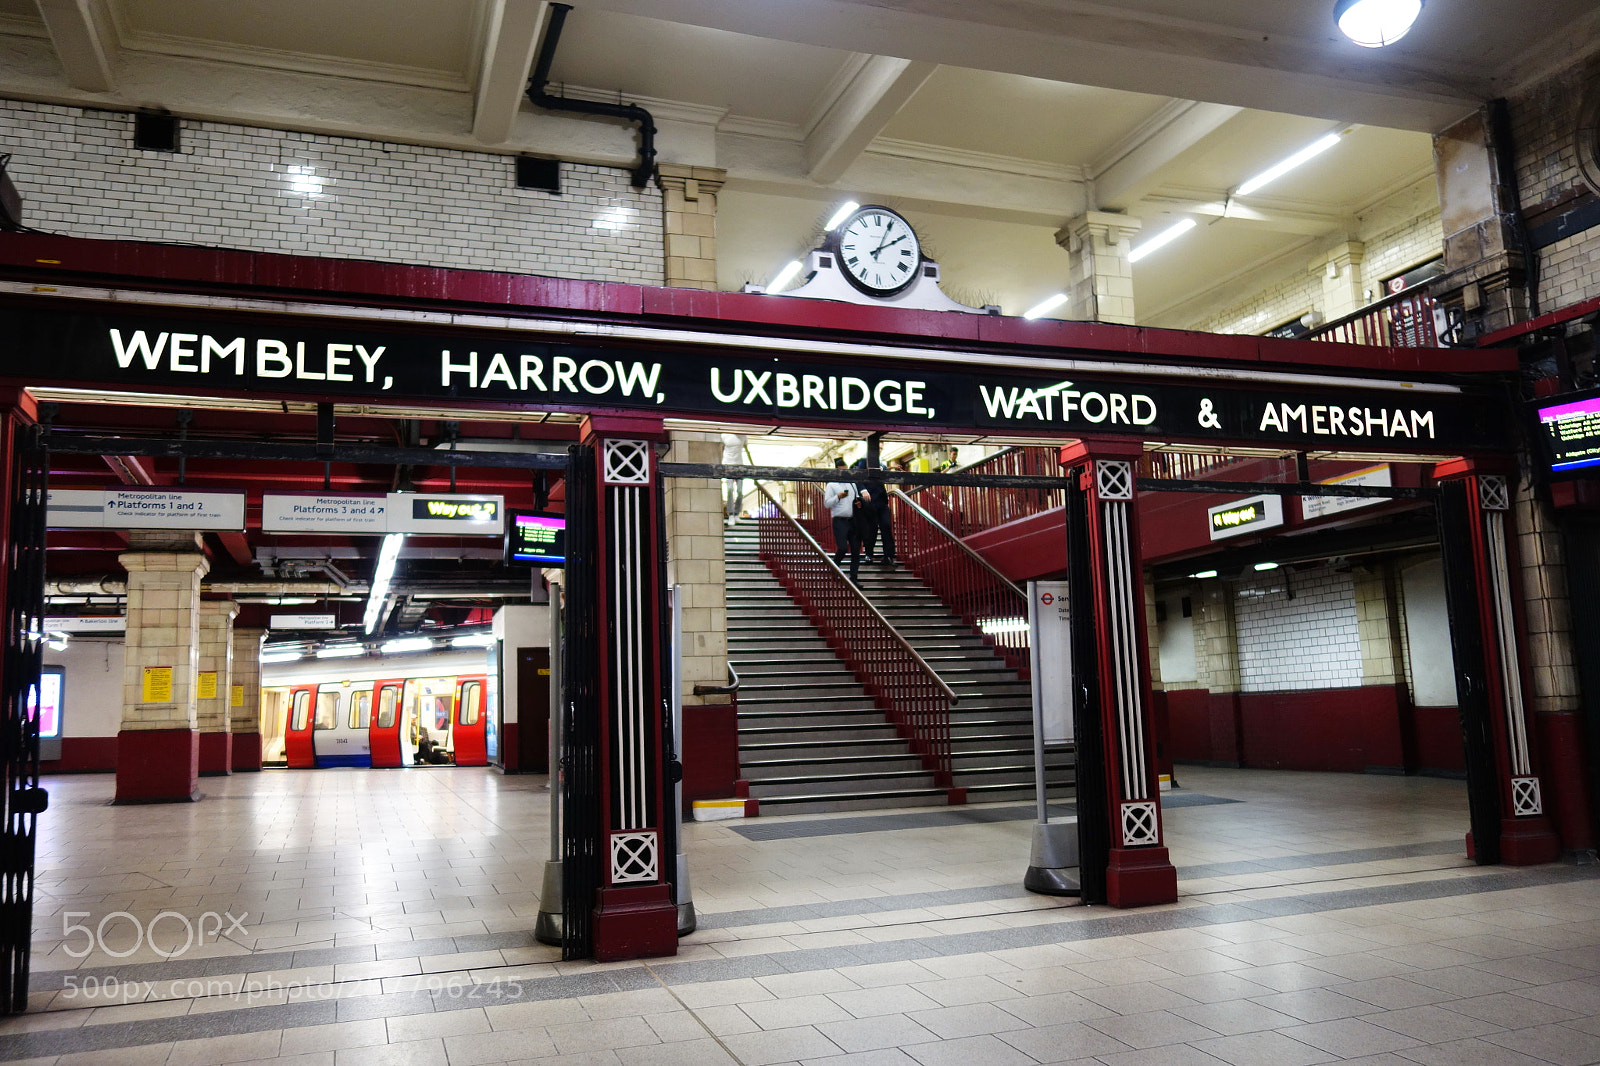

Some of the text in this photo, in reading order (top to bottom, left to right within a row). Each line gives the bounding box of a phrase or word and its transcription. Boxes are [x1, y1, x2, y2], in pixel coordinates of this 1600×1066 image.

[109, 328, 1435, 439] WEMBLEY, HARROW, UXBRIDGE, WATFORD & AMERSHAM
[118, 492, 167, 501] Metropolitan
[118, 501, 166, 509] Platforms
[177, 502, 194, 510] and
[294, 505, 338, 514] Platforms
[428, 501, 482, 518] Way out
